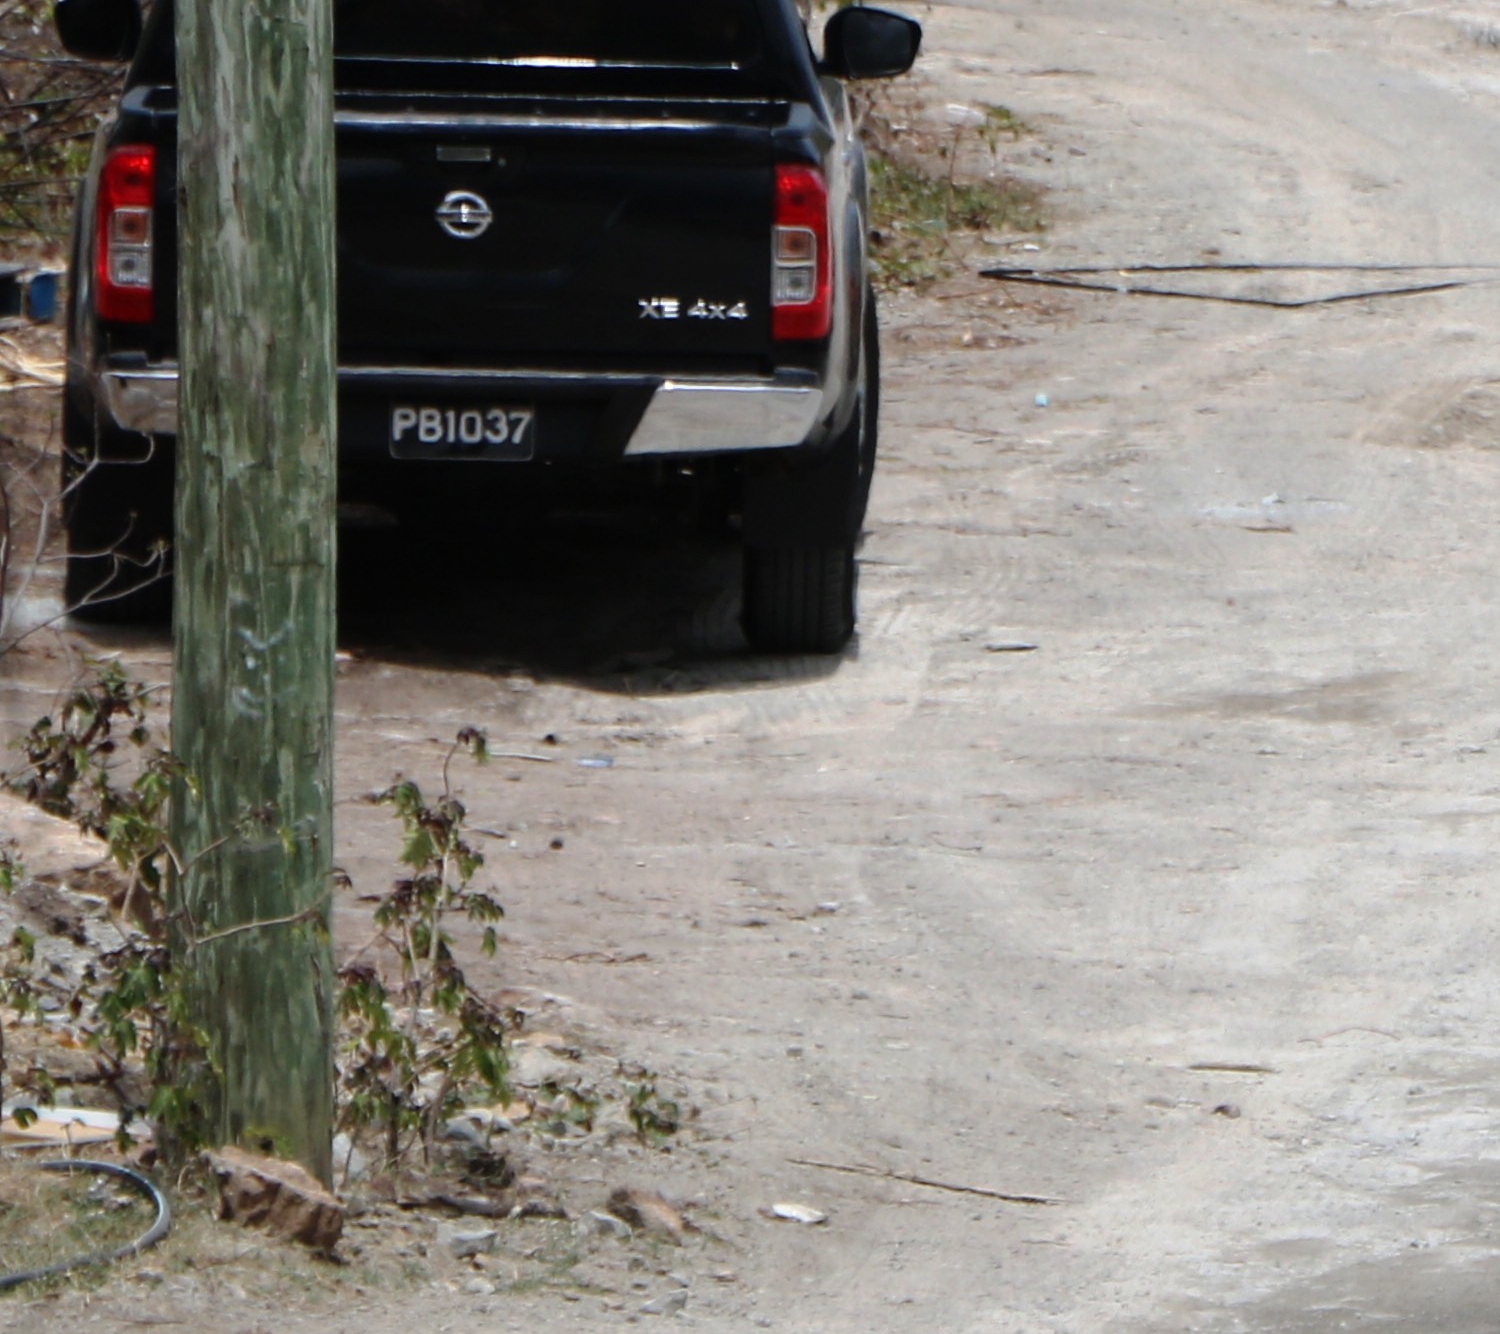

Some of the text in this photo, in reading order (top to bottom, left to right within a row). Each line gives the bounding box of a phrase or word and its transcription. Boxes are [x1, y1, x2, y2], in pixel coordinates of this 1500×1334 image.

[638, 297, 748, 319] XE 4x4
[392, 408, 532, 443] PB1037
